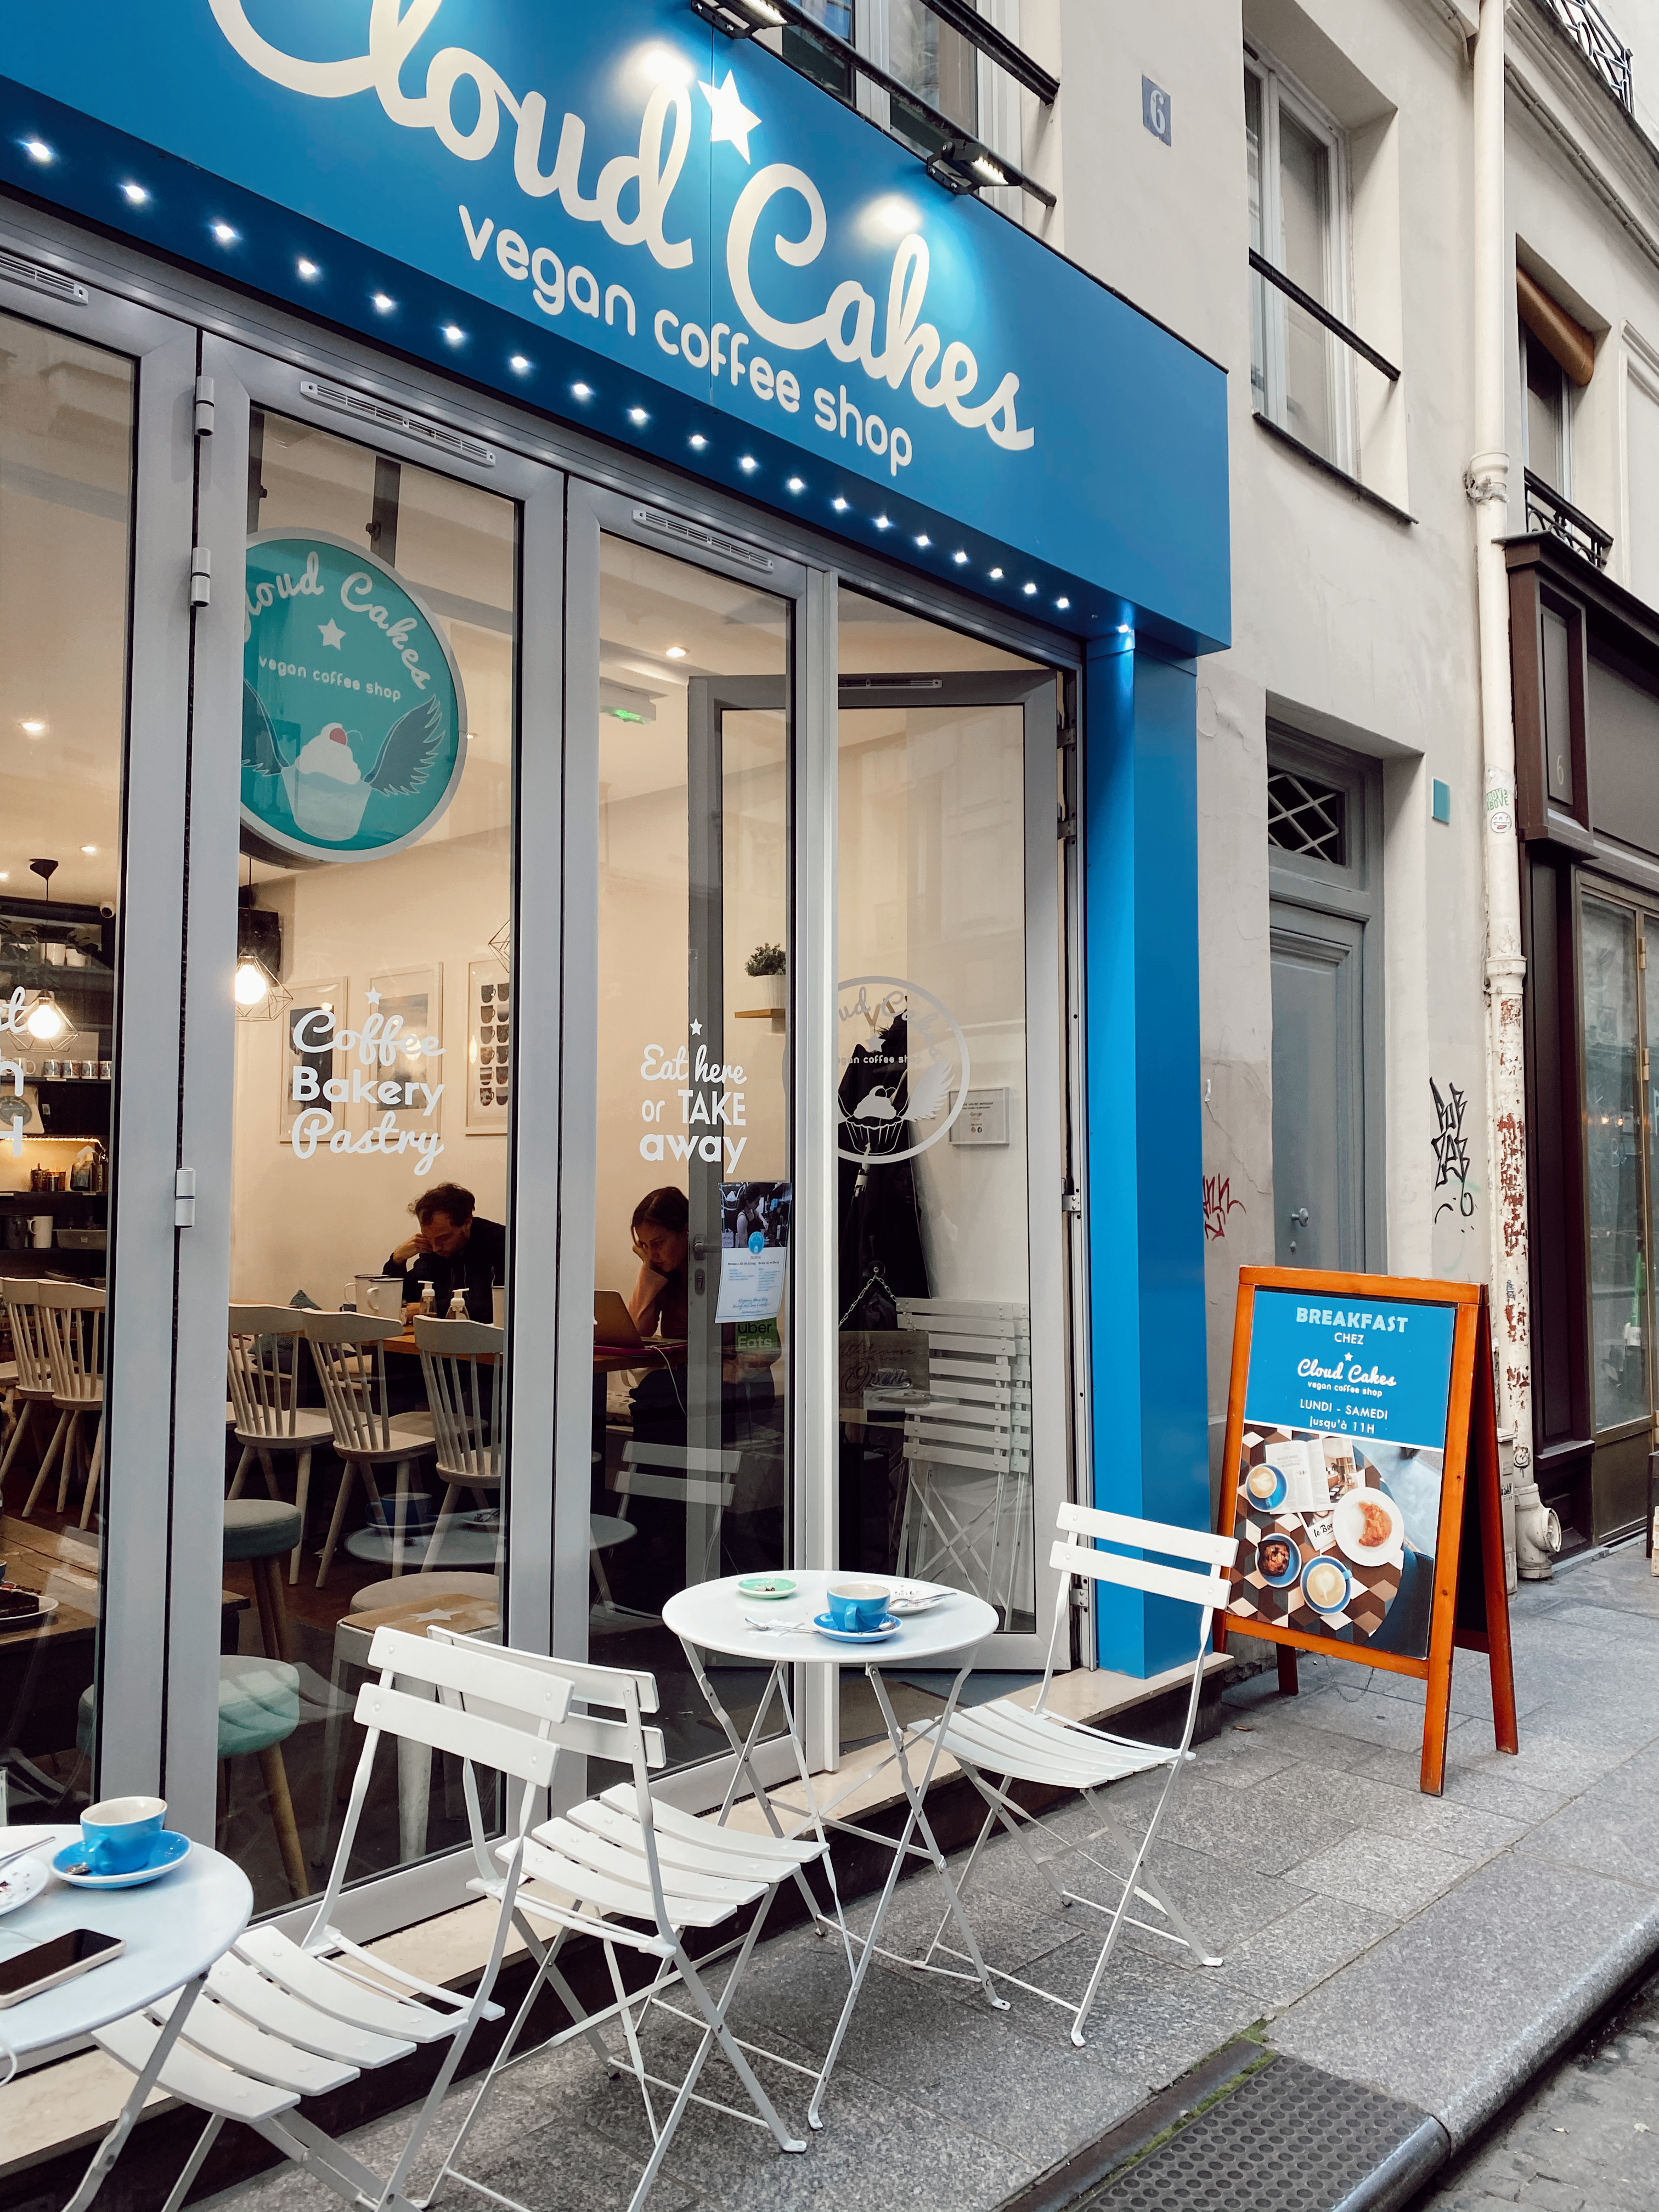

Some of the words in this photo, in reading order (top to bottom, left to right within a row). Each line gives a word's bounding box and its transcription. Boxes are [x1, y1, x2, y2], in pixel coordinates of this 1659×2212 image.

[1150, 89, 1166, 134] 6
[726, 163, 1034, 450] Cakes
[458, 205, 636, 336] vegan
[654, 308, 800, 413] coffee
[814, 384, 913, 476] shop
[244, 551, 324, 643] oud
[341, 572, 431, 690] Cakes
[259, 656, 307, 678] vegan
[313, 670, 360, 690] coffee
[366, 681, 401, 703] shop
[292, 1009, 447, 1066] Coffee
[640, 1043, 689, 1081] Eat
[695, 1044, 748, 1085] here
[863, 1055, 895, 1064] coffee
[292, 1065, 445, 1116] Bakery
[641, 1099, 665, 1122] or
[678, 1089, 747, 1126] TAKE
[291, 1107, 445, 1176] Pastry
[639, 1133, 748, 1174] away
[1296, 1307, 1409, 1333] BREAKFAST
[1334, 1332, 1364, 1345] CHEZ
[738, 1335, 772, 1349] Eats
[1297, 1358, 1344, 1380] Cloud
[1348, 1364, 1397, 1386] Cakes
[1307, 1381, 1331, 1391] vegan
[1334, 1384, 1359, 1394] coffee
[1362, 1387, 1383, 1398] shop
[1300, 1398, 1332, 1412] LUNDI
[1345, 1404, 1388, 1420] SAMEDI
[1310, 1415, 1347, 1430] jusqu'à
